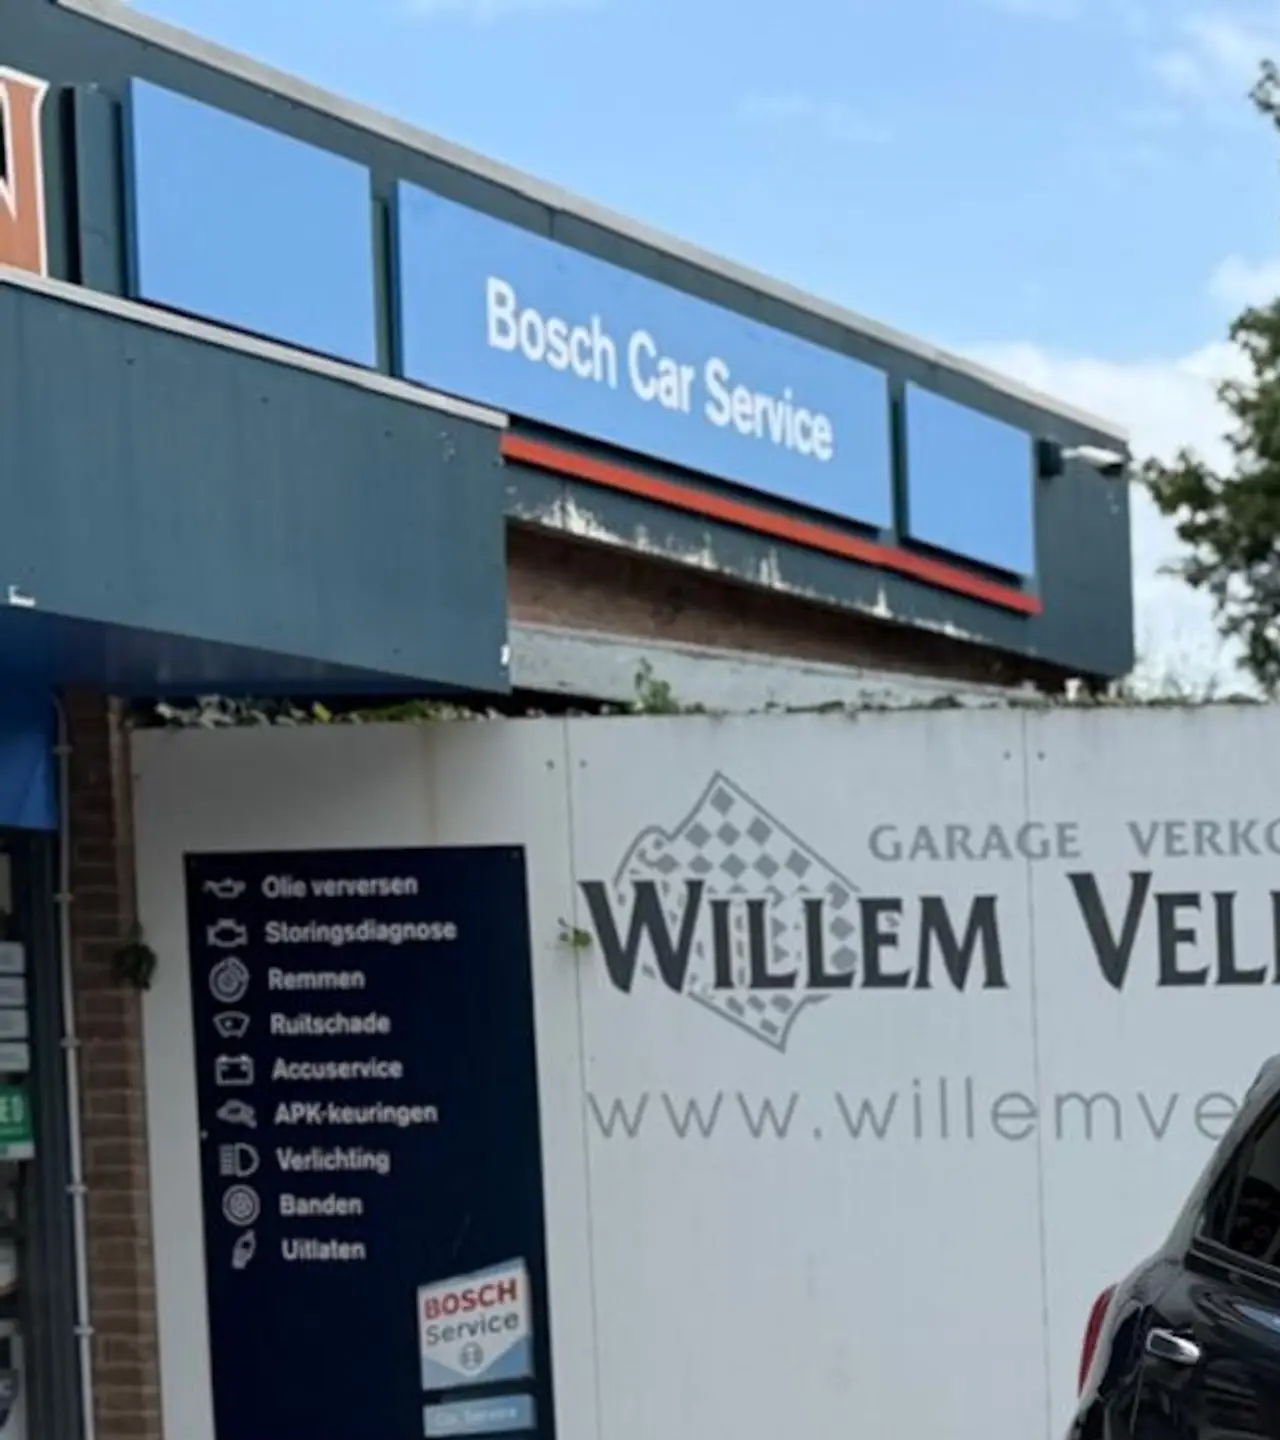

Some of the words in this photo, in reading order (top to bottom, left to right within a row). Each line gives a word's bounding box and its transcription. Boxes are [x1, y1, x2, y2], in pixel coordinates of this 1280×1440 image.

[486, 276, 617, 389] Bosch
[627, 329, 695, 414] Car
[704, 357, 834, 462] Service
[867, 820, 1082, 863] GARAGE
[261, 874, 307, 898] Olie
[311, 876, 419, 897] verversen
[264, 918, 458, 946] Storingsdiagnose
[577, 877, 1008, 994] WILLEM
[267, 967, 366, 991] Remmen
[270, 1011, 391, 1035] Ruitschade
[271, 1056, 404, 1081] Accuservice
[274, 1101, 439, 1128] APK-keuringen
[275, 1146, 391, 1175] Verlichting
[279, 1193, 364, 1216] Banden
[281, 1238, 366, 1261] Uitlaten
[424, 1277, 518, 1321] BOSCH
[426, 1312, 519, 1345] Service
